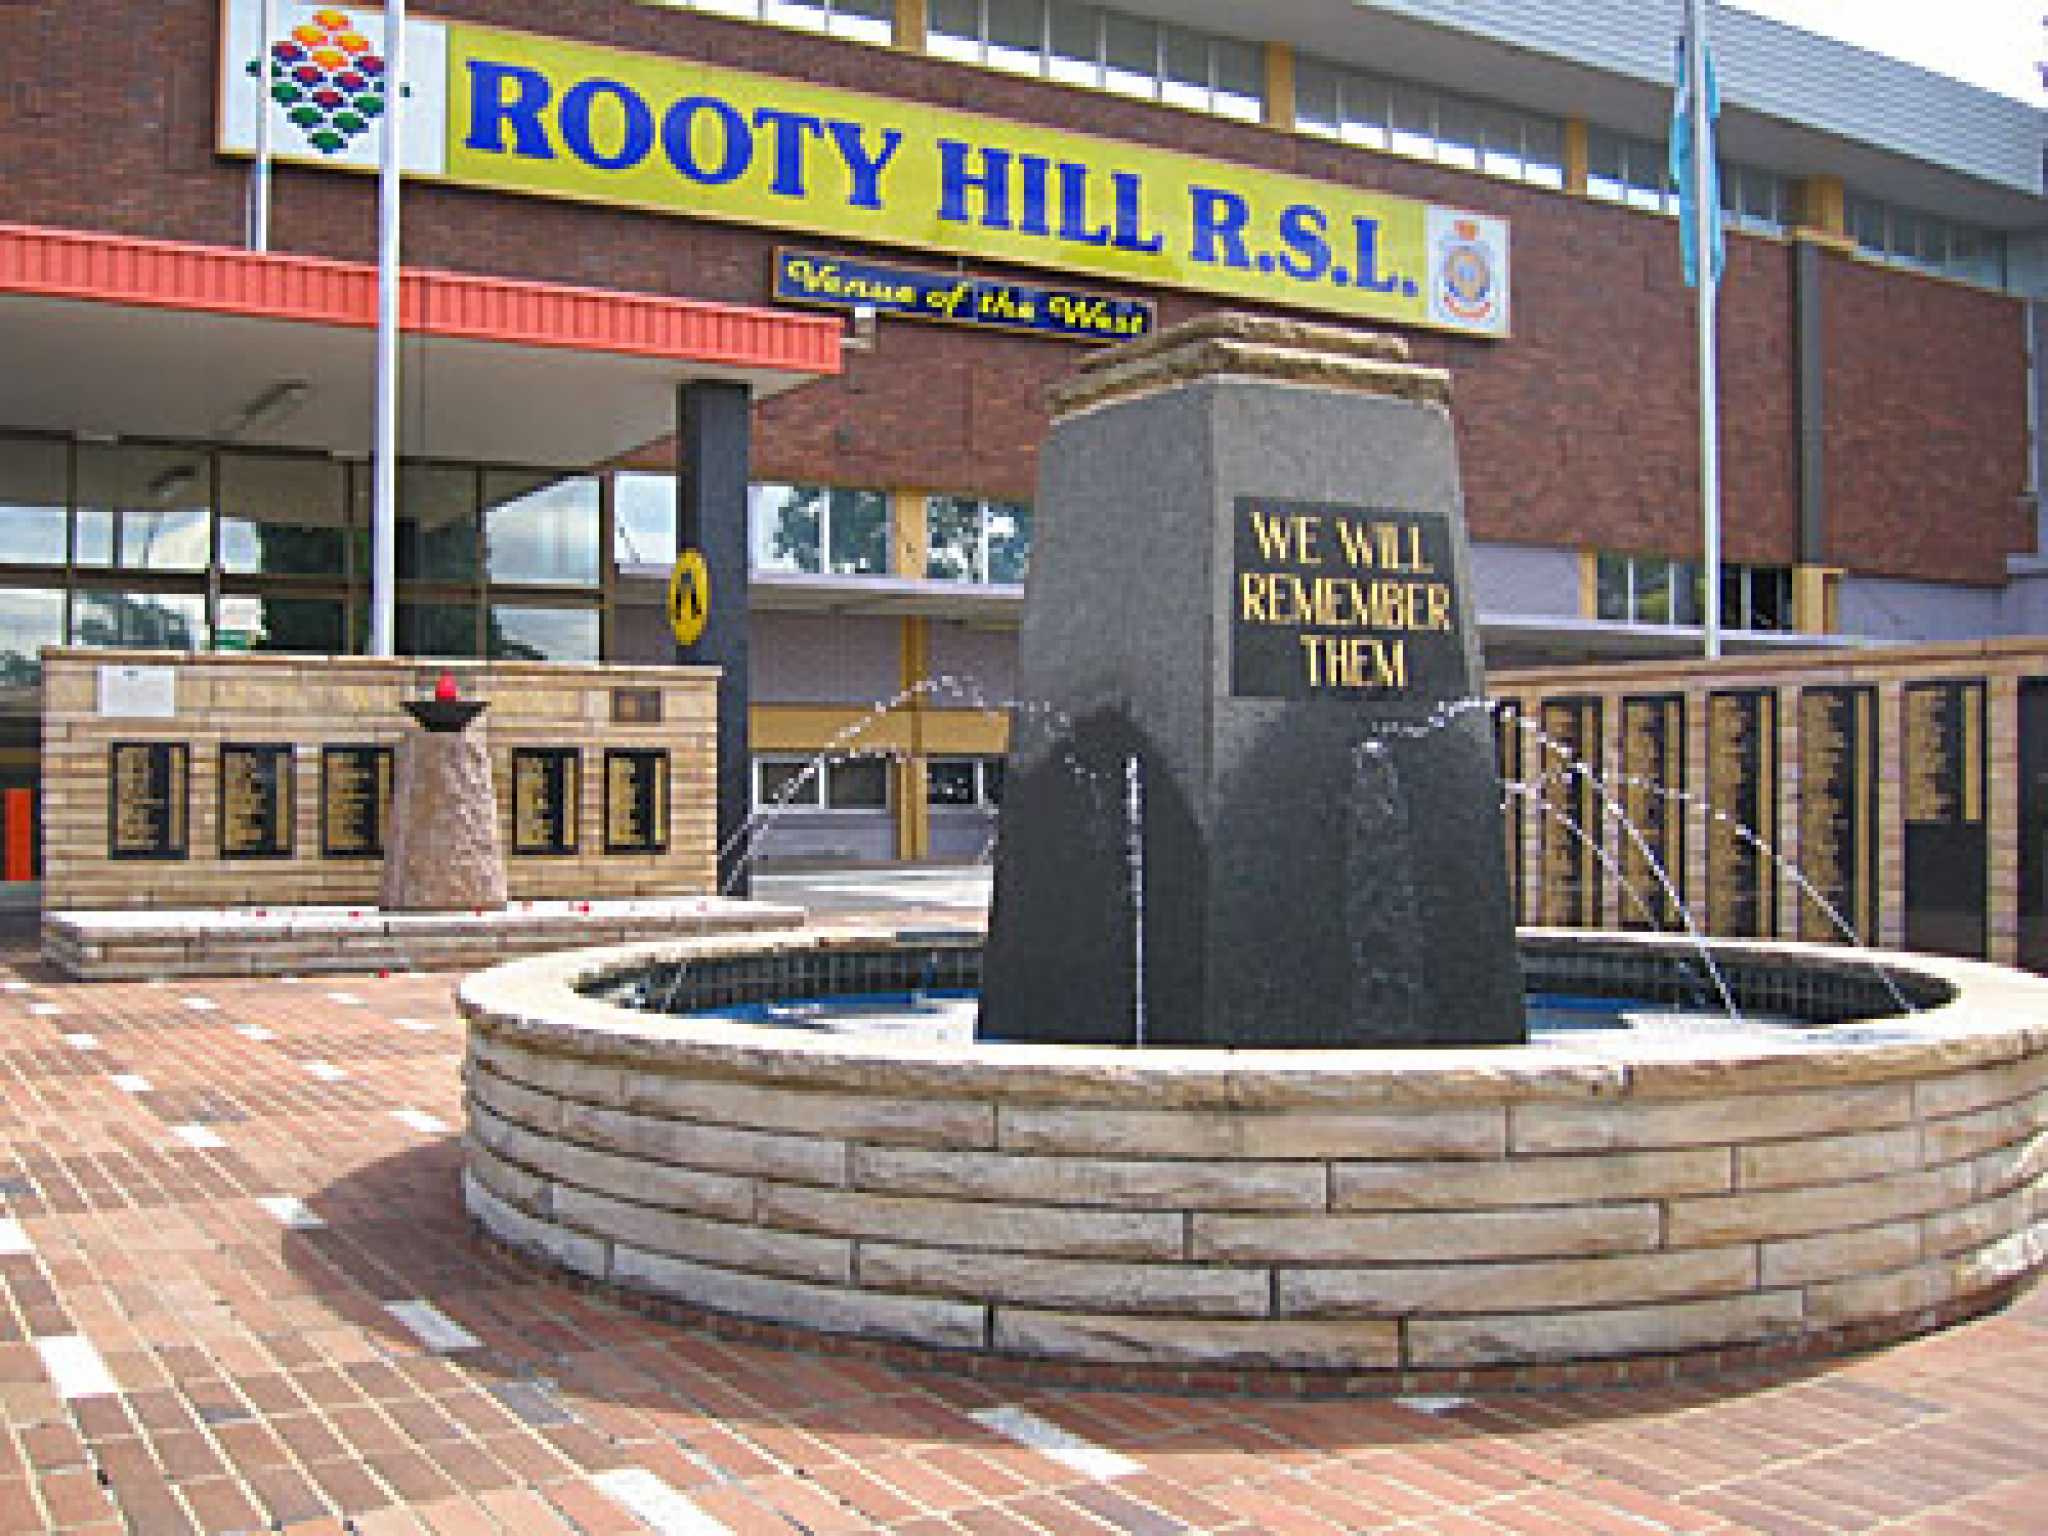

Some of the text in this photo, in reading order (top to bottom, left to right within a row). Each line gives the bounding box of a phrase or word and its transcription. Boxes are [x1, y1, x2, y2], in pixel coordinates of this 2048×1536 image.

[465, 57, 1418, 297] ROOTY HILL R.S.L.
[787, 259, 1145, 335] Venue of the West
[1249, 511, 1434, 574] WE WILL
[1239, 573, 1450, 631] REMEMBER
[1300, 635, 1408, 691] THEM
